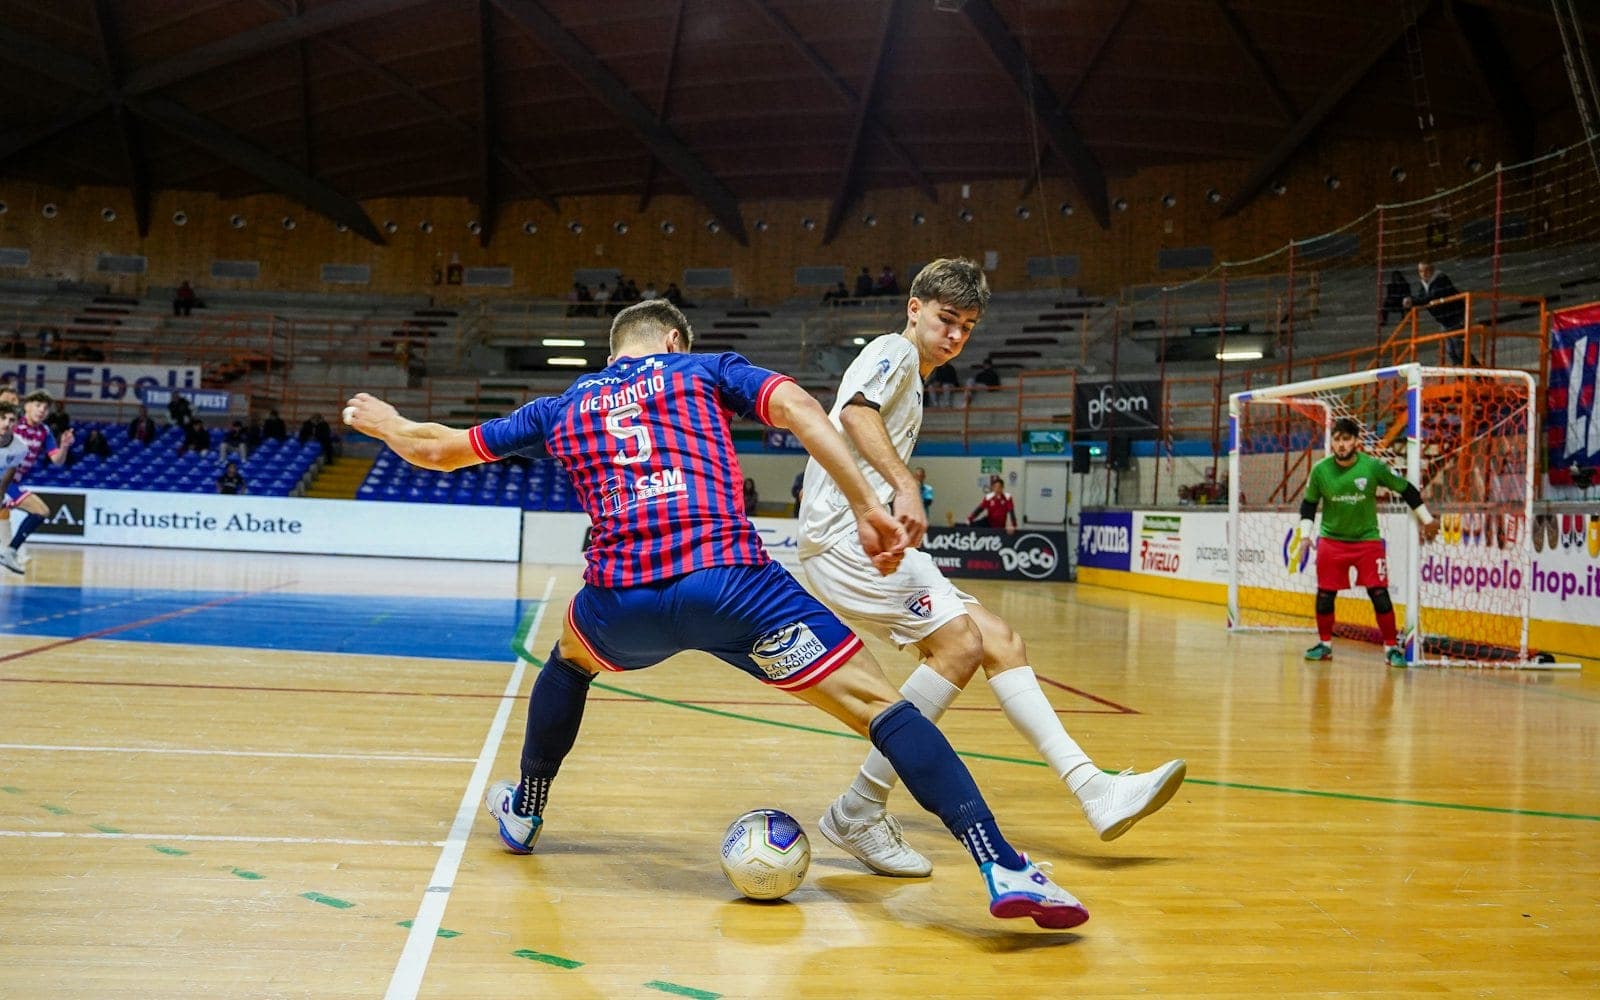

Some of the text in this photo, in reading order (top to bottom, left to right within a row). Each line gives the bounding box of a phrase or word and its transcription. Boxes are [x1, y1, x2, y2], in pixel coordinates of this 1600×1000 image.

[606, 403, 652, 465] 5
[636, 467, 683, 491] CSM
[93, 507, 217, 531] Industrie
[226, 513, 302, 534] Abate
[764, 637, 819, 673] CALZATURE
[785, 643, 823, 671] POPOLO
